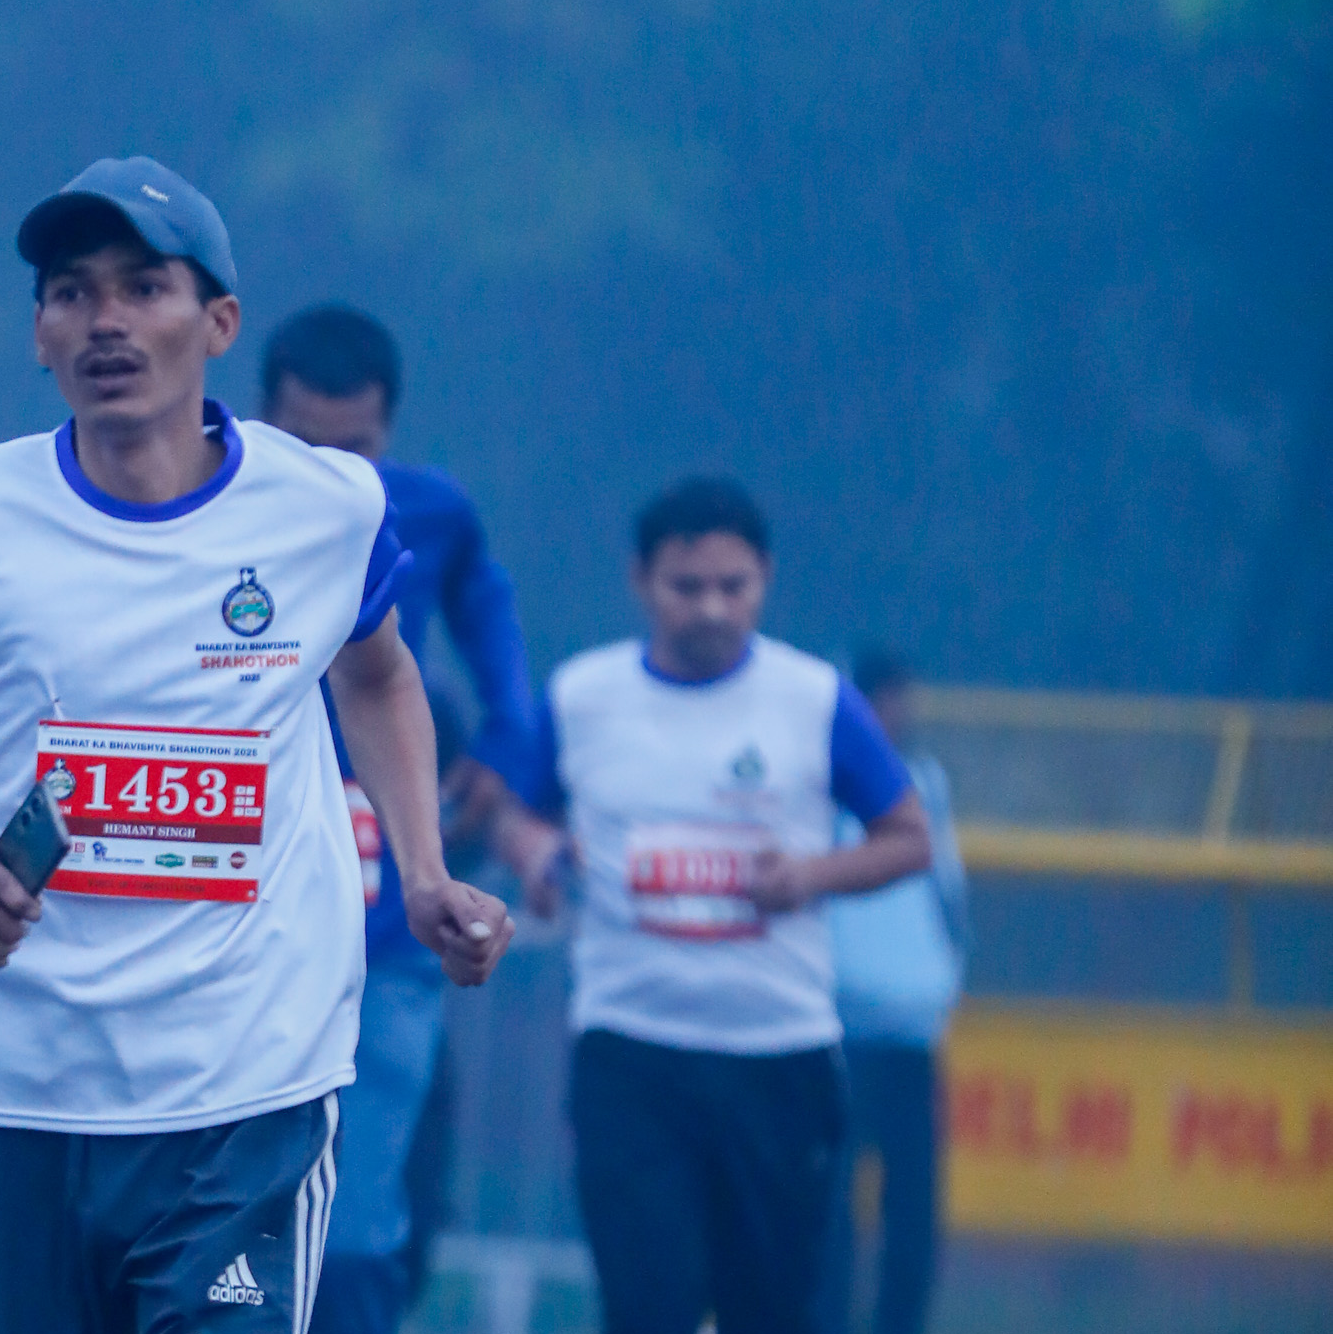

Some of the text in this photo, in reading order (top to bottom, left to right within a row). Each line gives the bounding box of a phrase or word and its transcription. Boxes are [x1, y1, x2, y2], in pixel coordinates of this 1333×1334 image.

[195, 640, 302, 652] BHARAT KA BHAVISHYA
[49, 737, 91, 749] BHARAT
[92, 739, 107, 749] KA
[109, 740, 167, 753] BHAVISHYA
[84, 763, 228, 817] 1453
[103, 822, 196, 838] HEMANT SINGH
[207, 1283, 265, 1306] adidas
